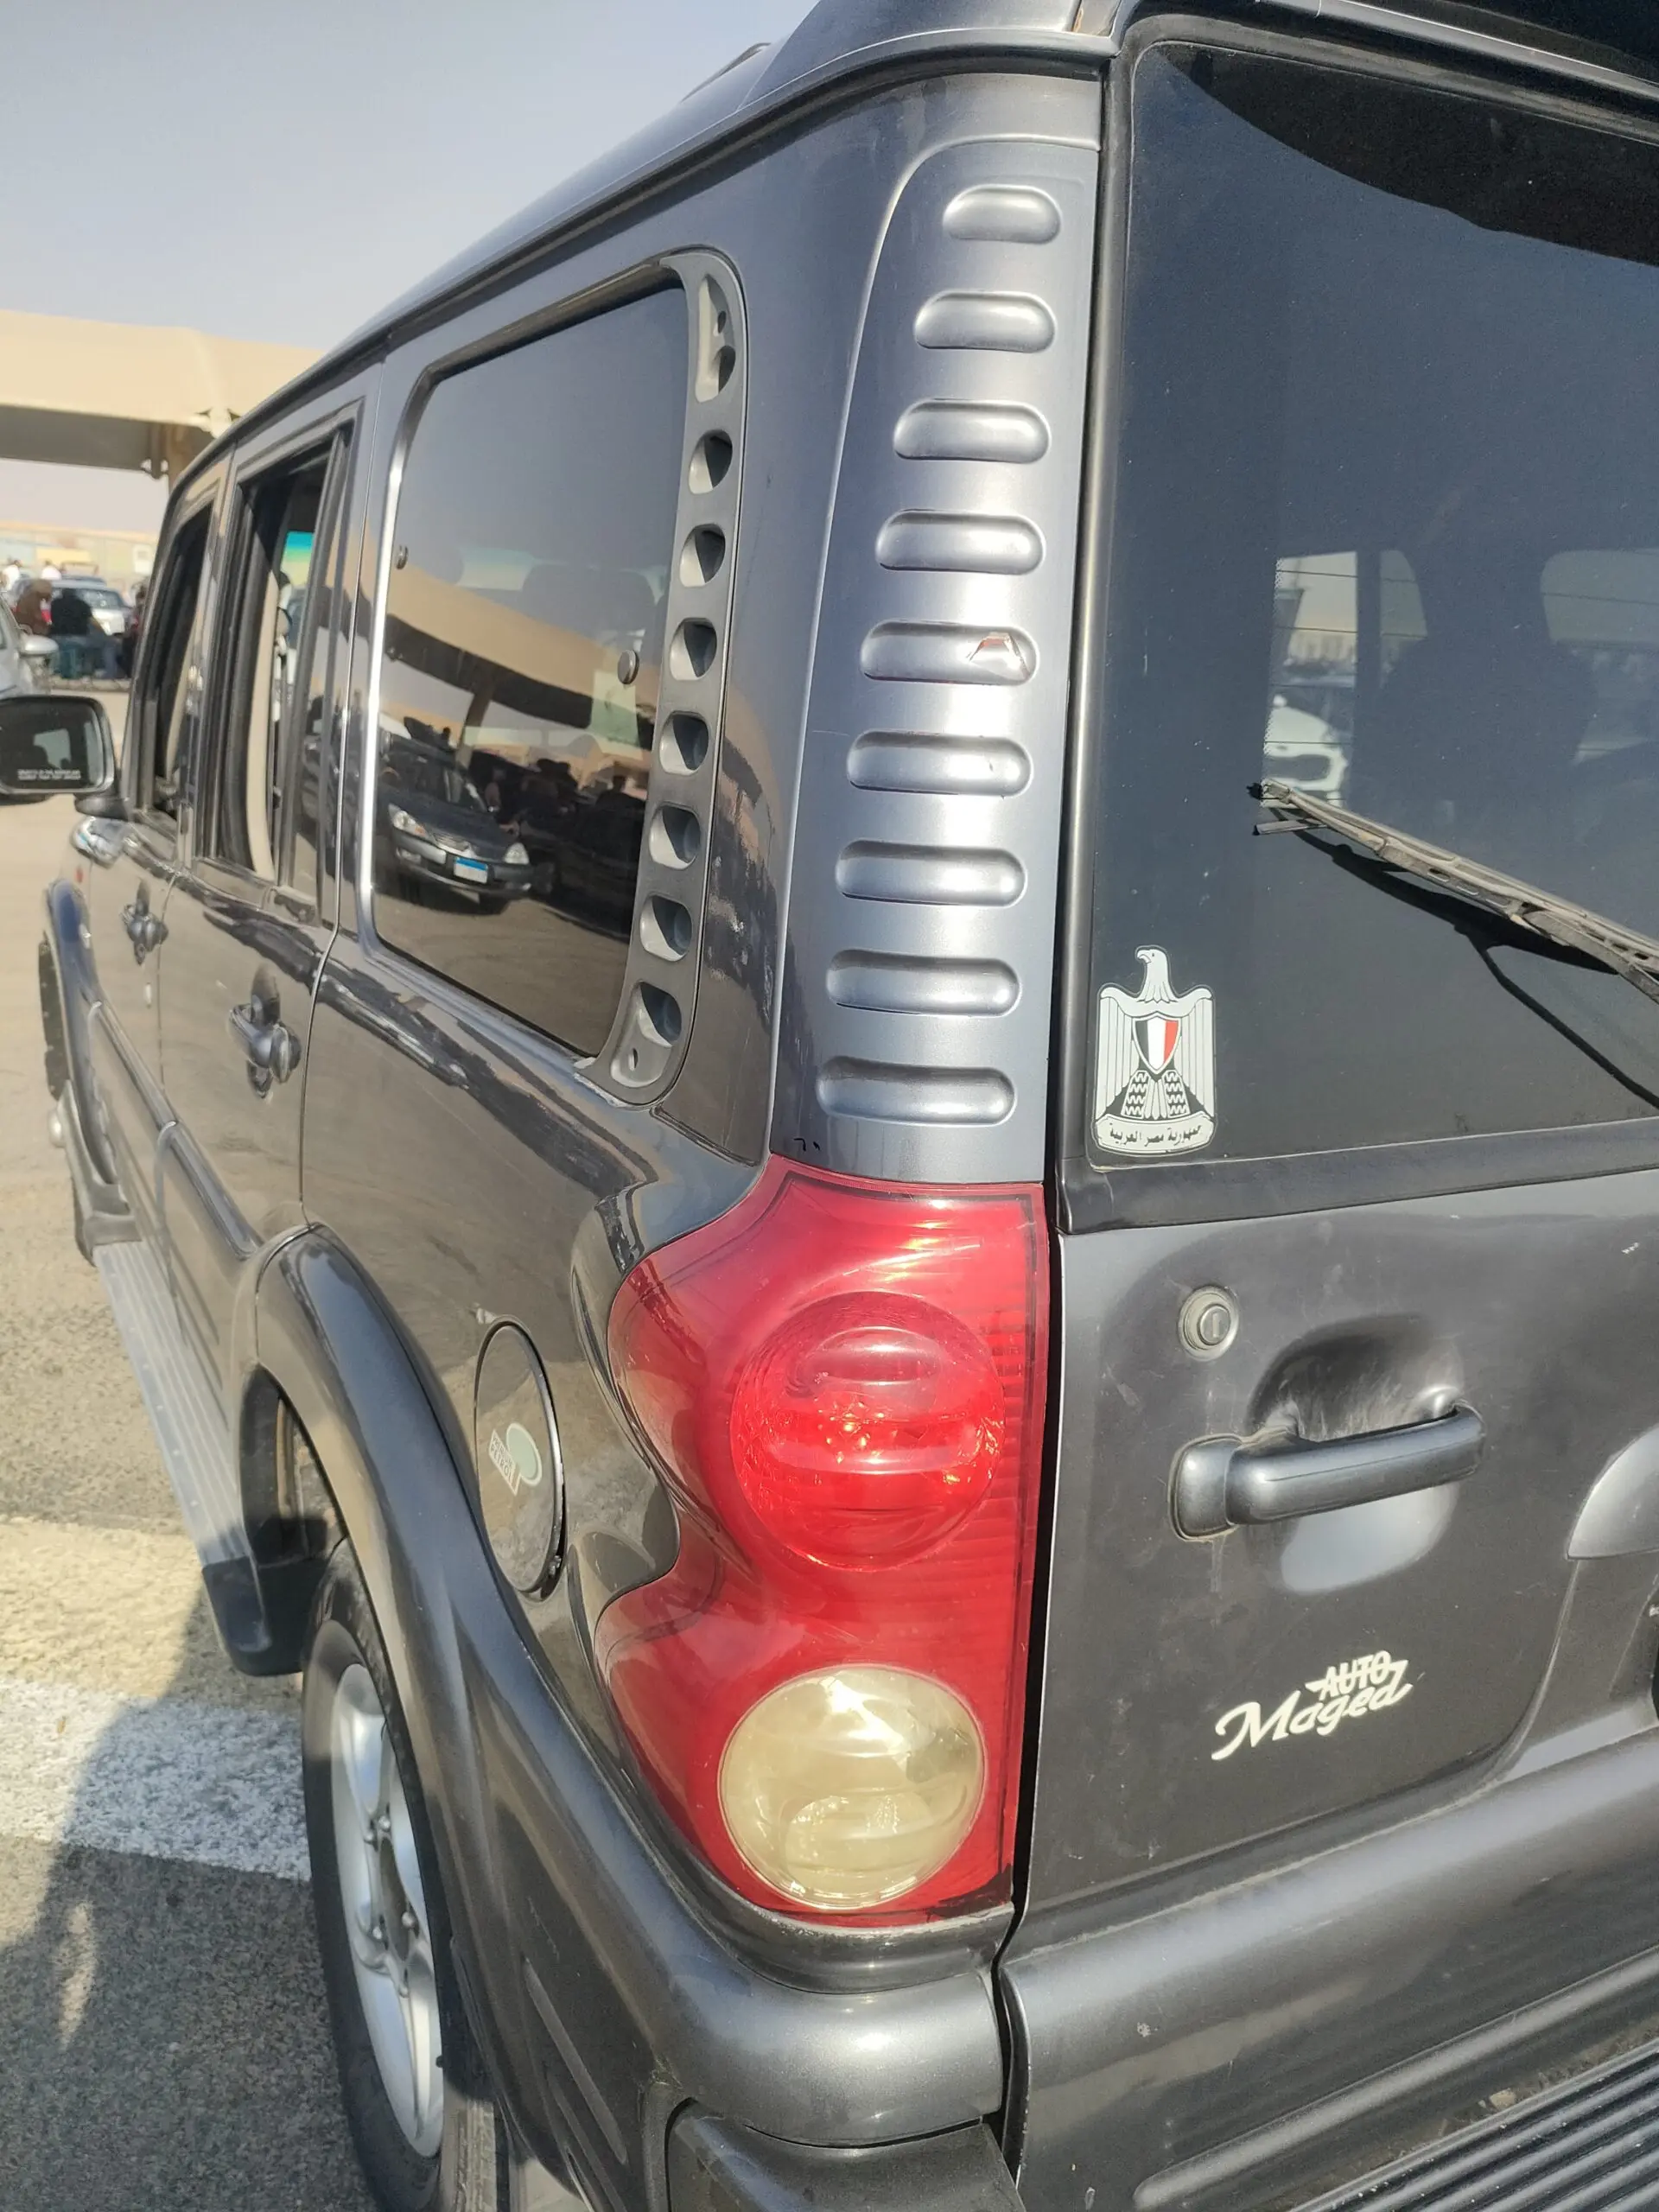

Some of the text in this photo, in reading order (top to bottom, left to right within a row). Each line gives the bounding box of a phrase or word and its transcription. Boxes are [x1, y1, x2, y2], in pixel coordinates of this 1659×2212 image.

[1109, 1122, 1142, 1146] العربية
[1144, 1133, 1165, 1147] مصر
[1306, 1649, 1393, 1700] AUTO
[1211, 1659, 1414, 1761] Maged
